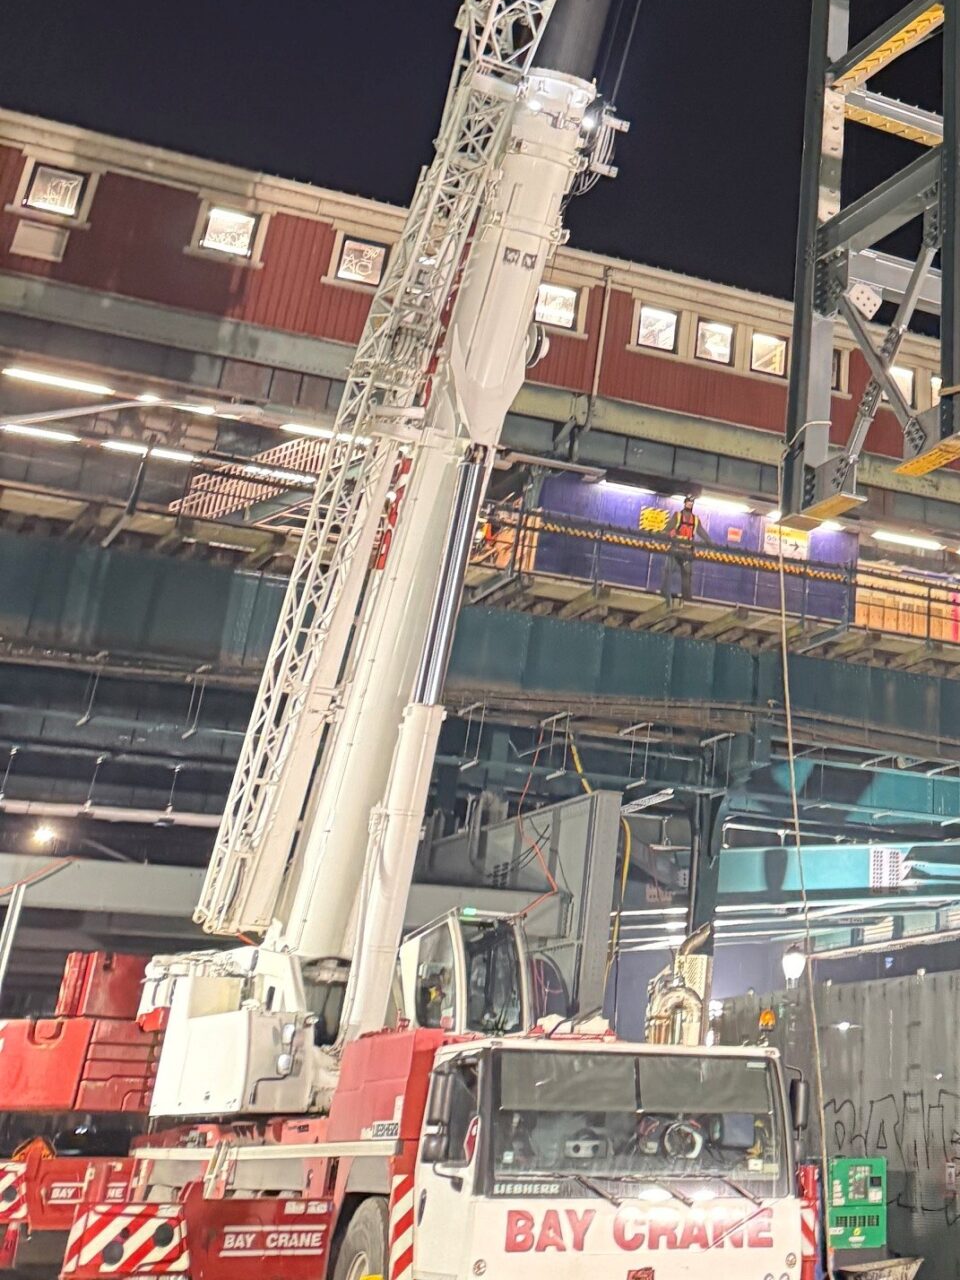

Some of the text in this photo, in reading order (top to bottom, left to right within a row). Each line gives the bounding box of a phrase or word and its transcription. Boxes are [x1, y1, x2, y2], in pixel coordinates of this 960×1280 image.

[51, 1187, 76, 1199] BAY
[493, 1183, 560, 1195] LIEBHERR
[505, 1206, 774, 1252] BAY CRANE
[223, 1231, 323, 1249] BAY CRANE
